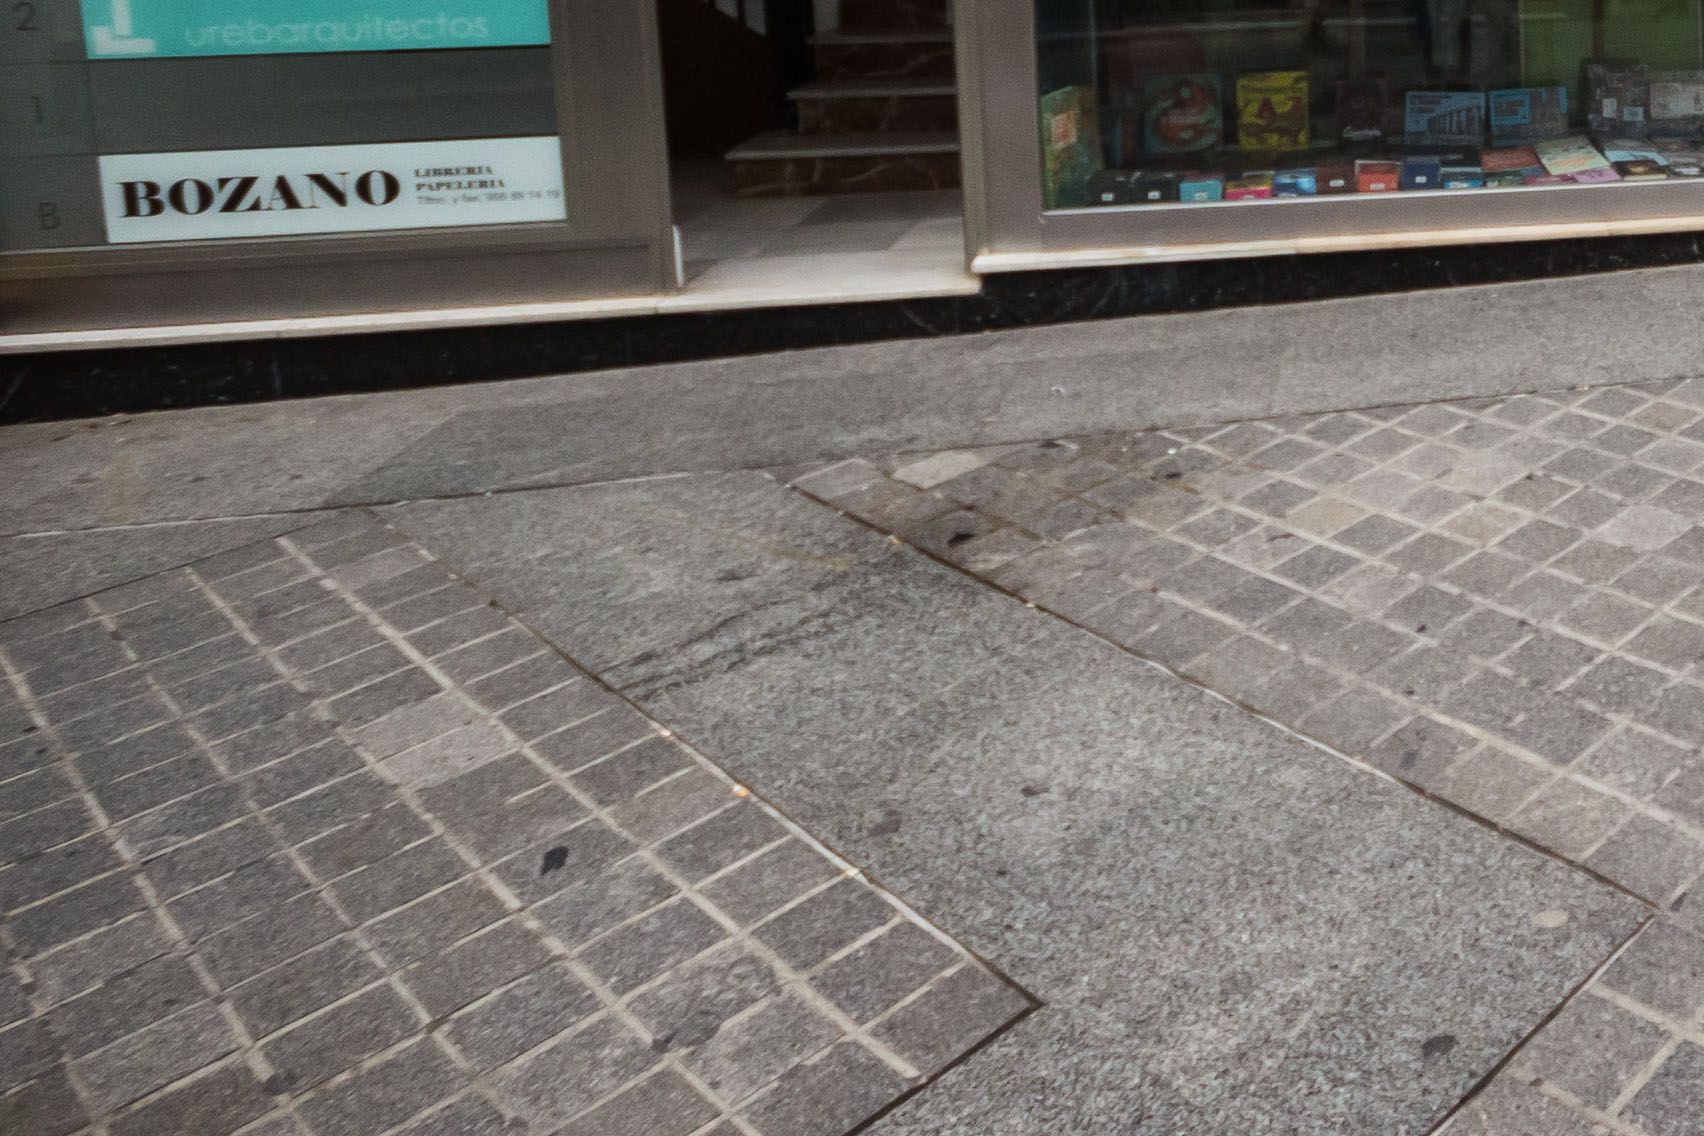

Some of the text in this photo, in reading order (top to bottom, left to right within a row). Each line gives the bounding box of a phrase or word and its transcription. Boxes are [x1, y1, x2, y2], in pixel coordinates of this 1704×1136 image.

[14, 2, 38, 32] 2
[184, 12, 490, 48] urebarquitectos
[116, 169, 401, 219] BOZANO
